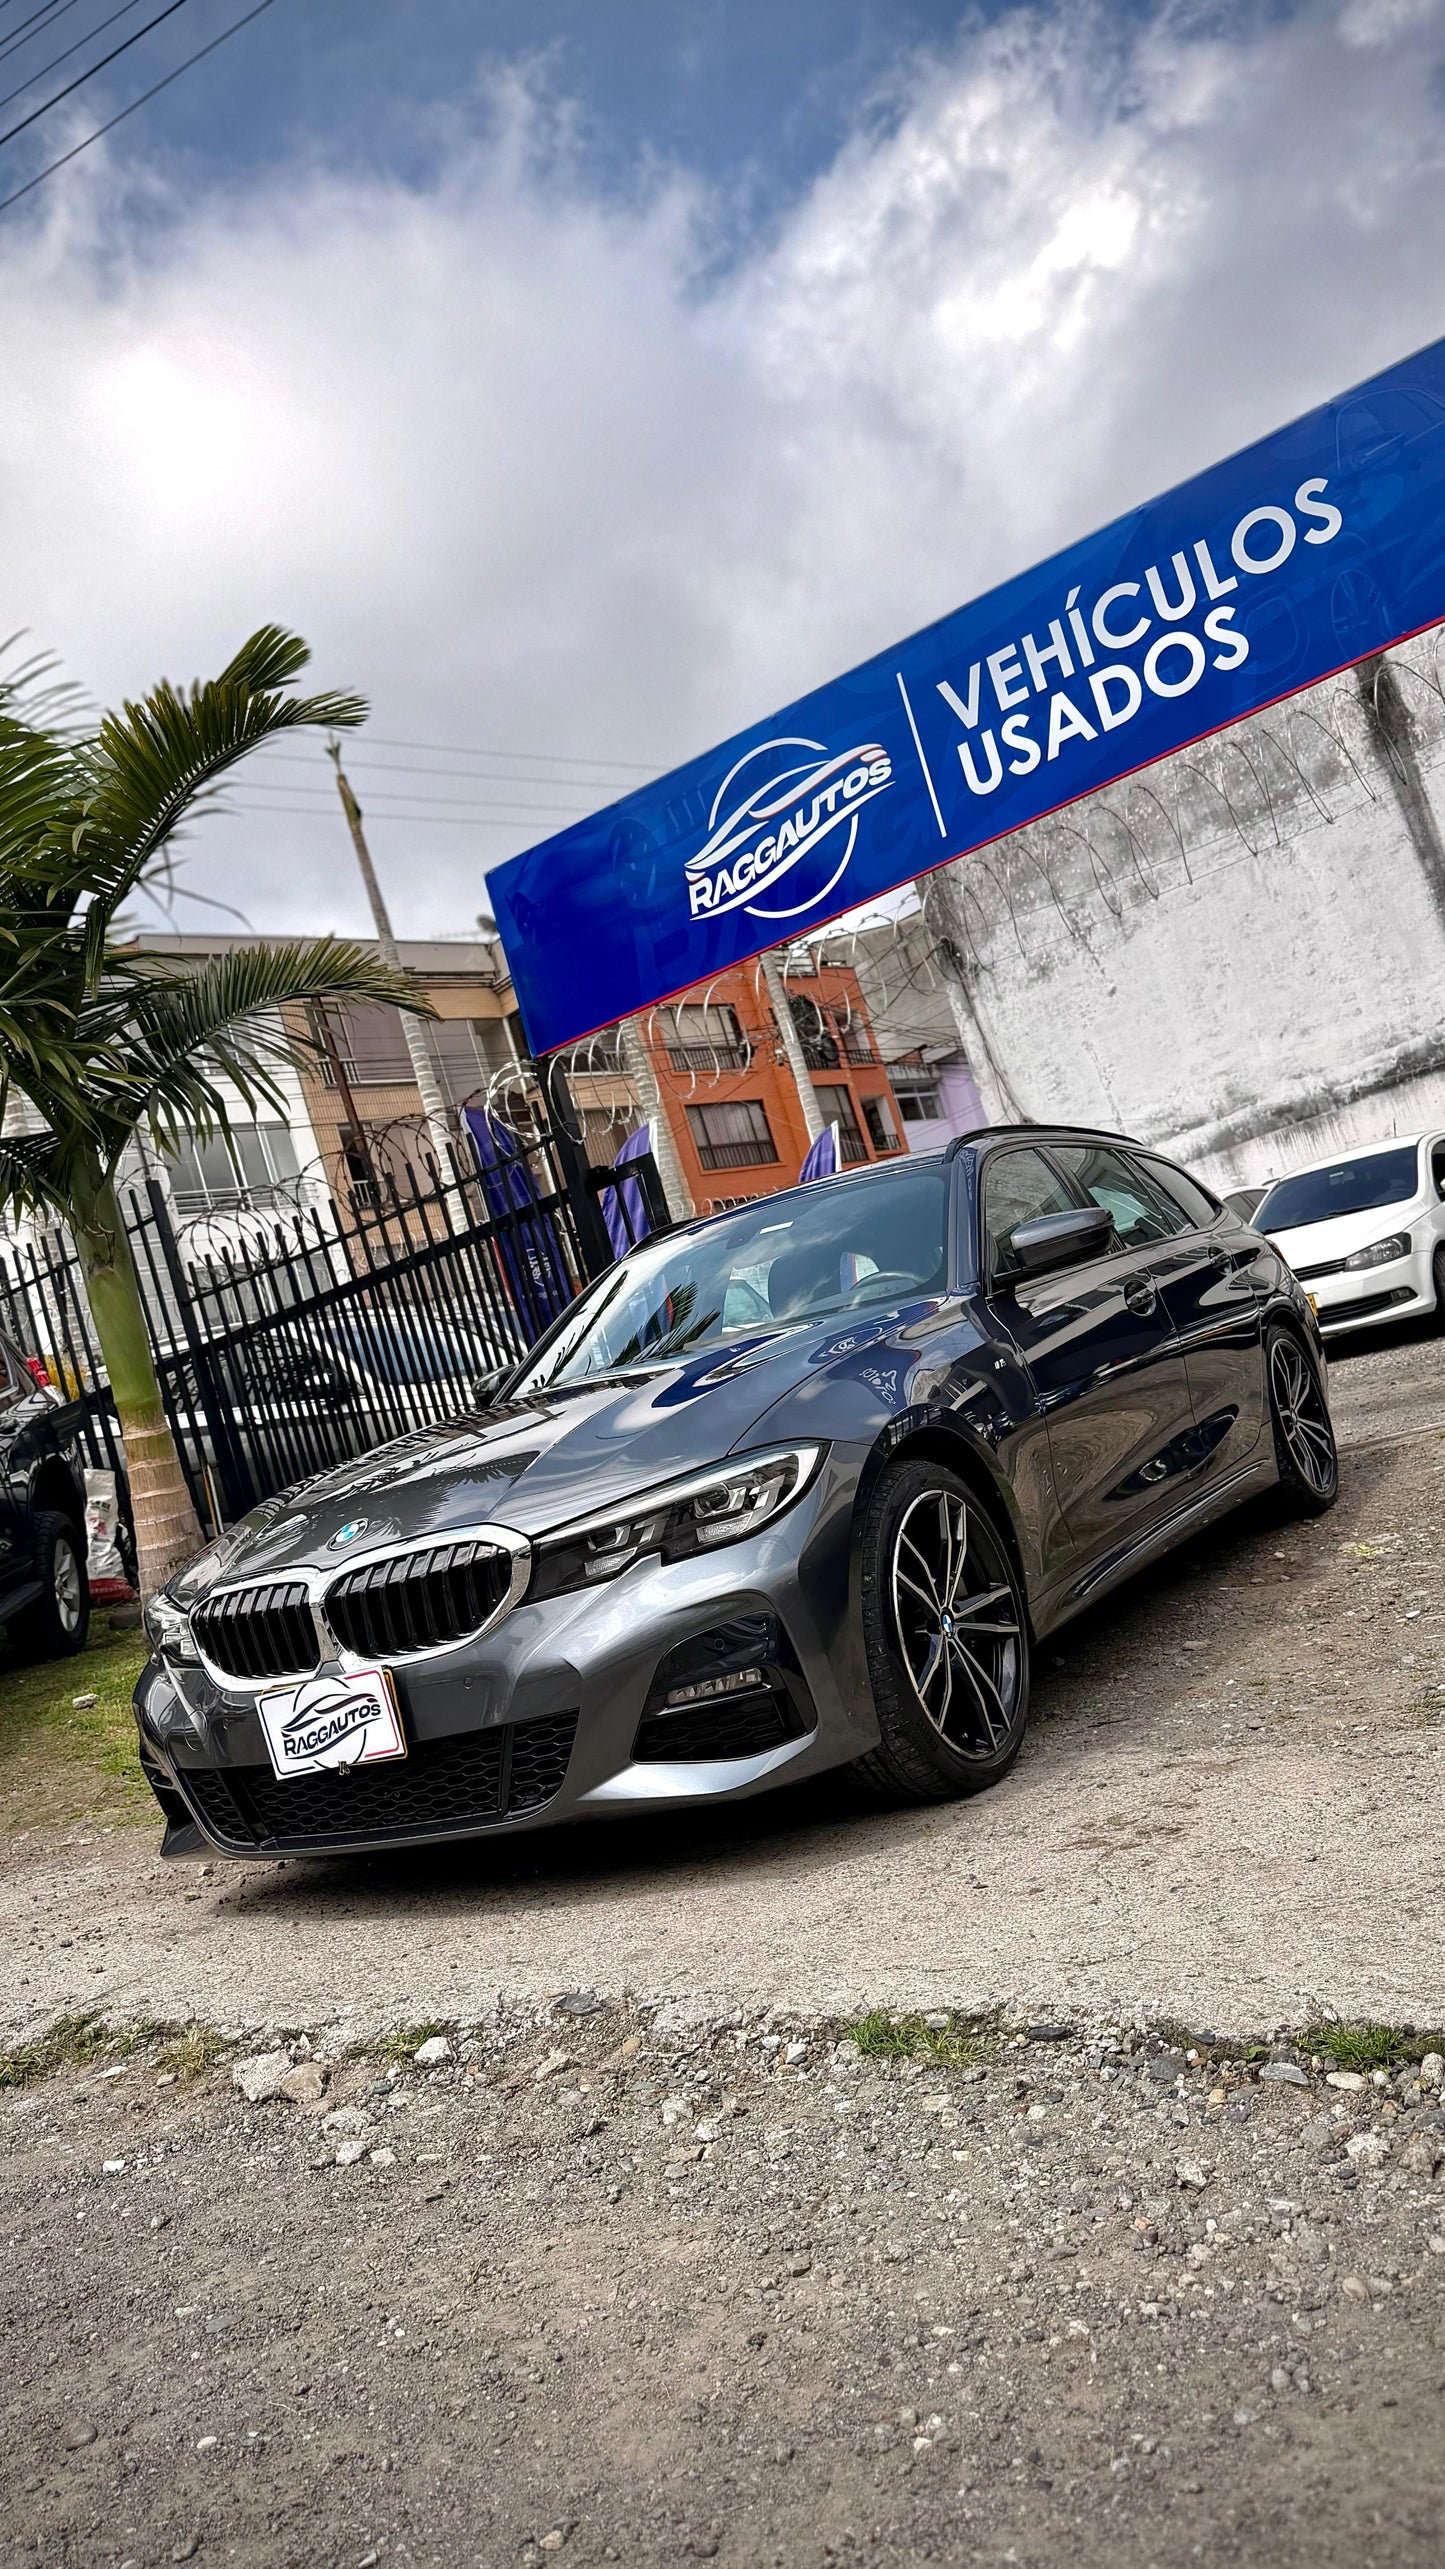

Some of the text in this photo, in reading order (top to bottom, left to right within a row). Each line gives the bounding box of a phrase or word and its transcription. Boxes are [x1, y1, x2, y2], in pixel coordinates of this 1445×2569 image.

[937, 477, 1343, 730] VEHÍCULOS
[957, 605, 1250, 796] USADOS
[688, 757, 892, 916] RAGGAUTOS
[283, 1704, 381, 1756] RAGGAUTOS
